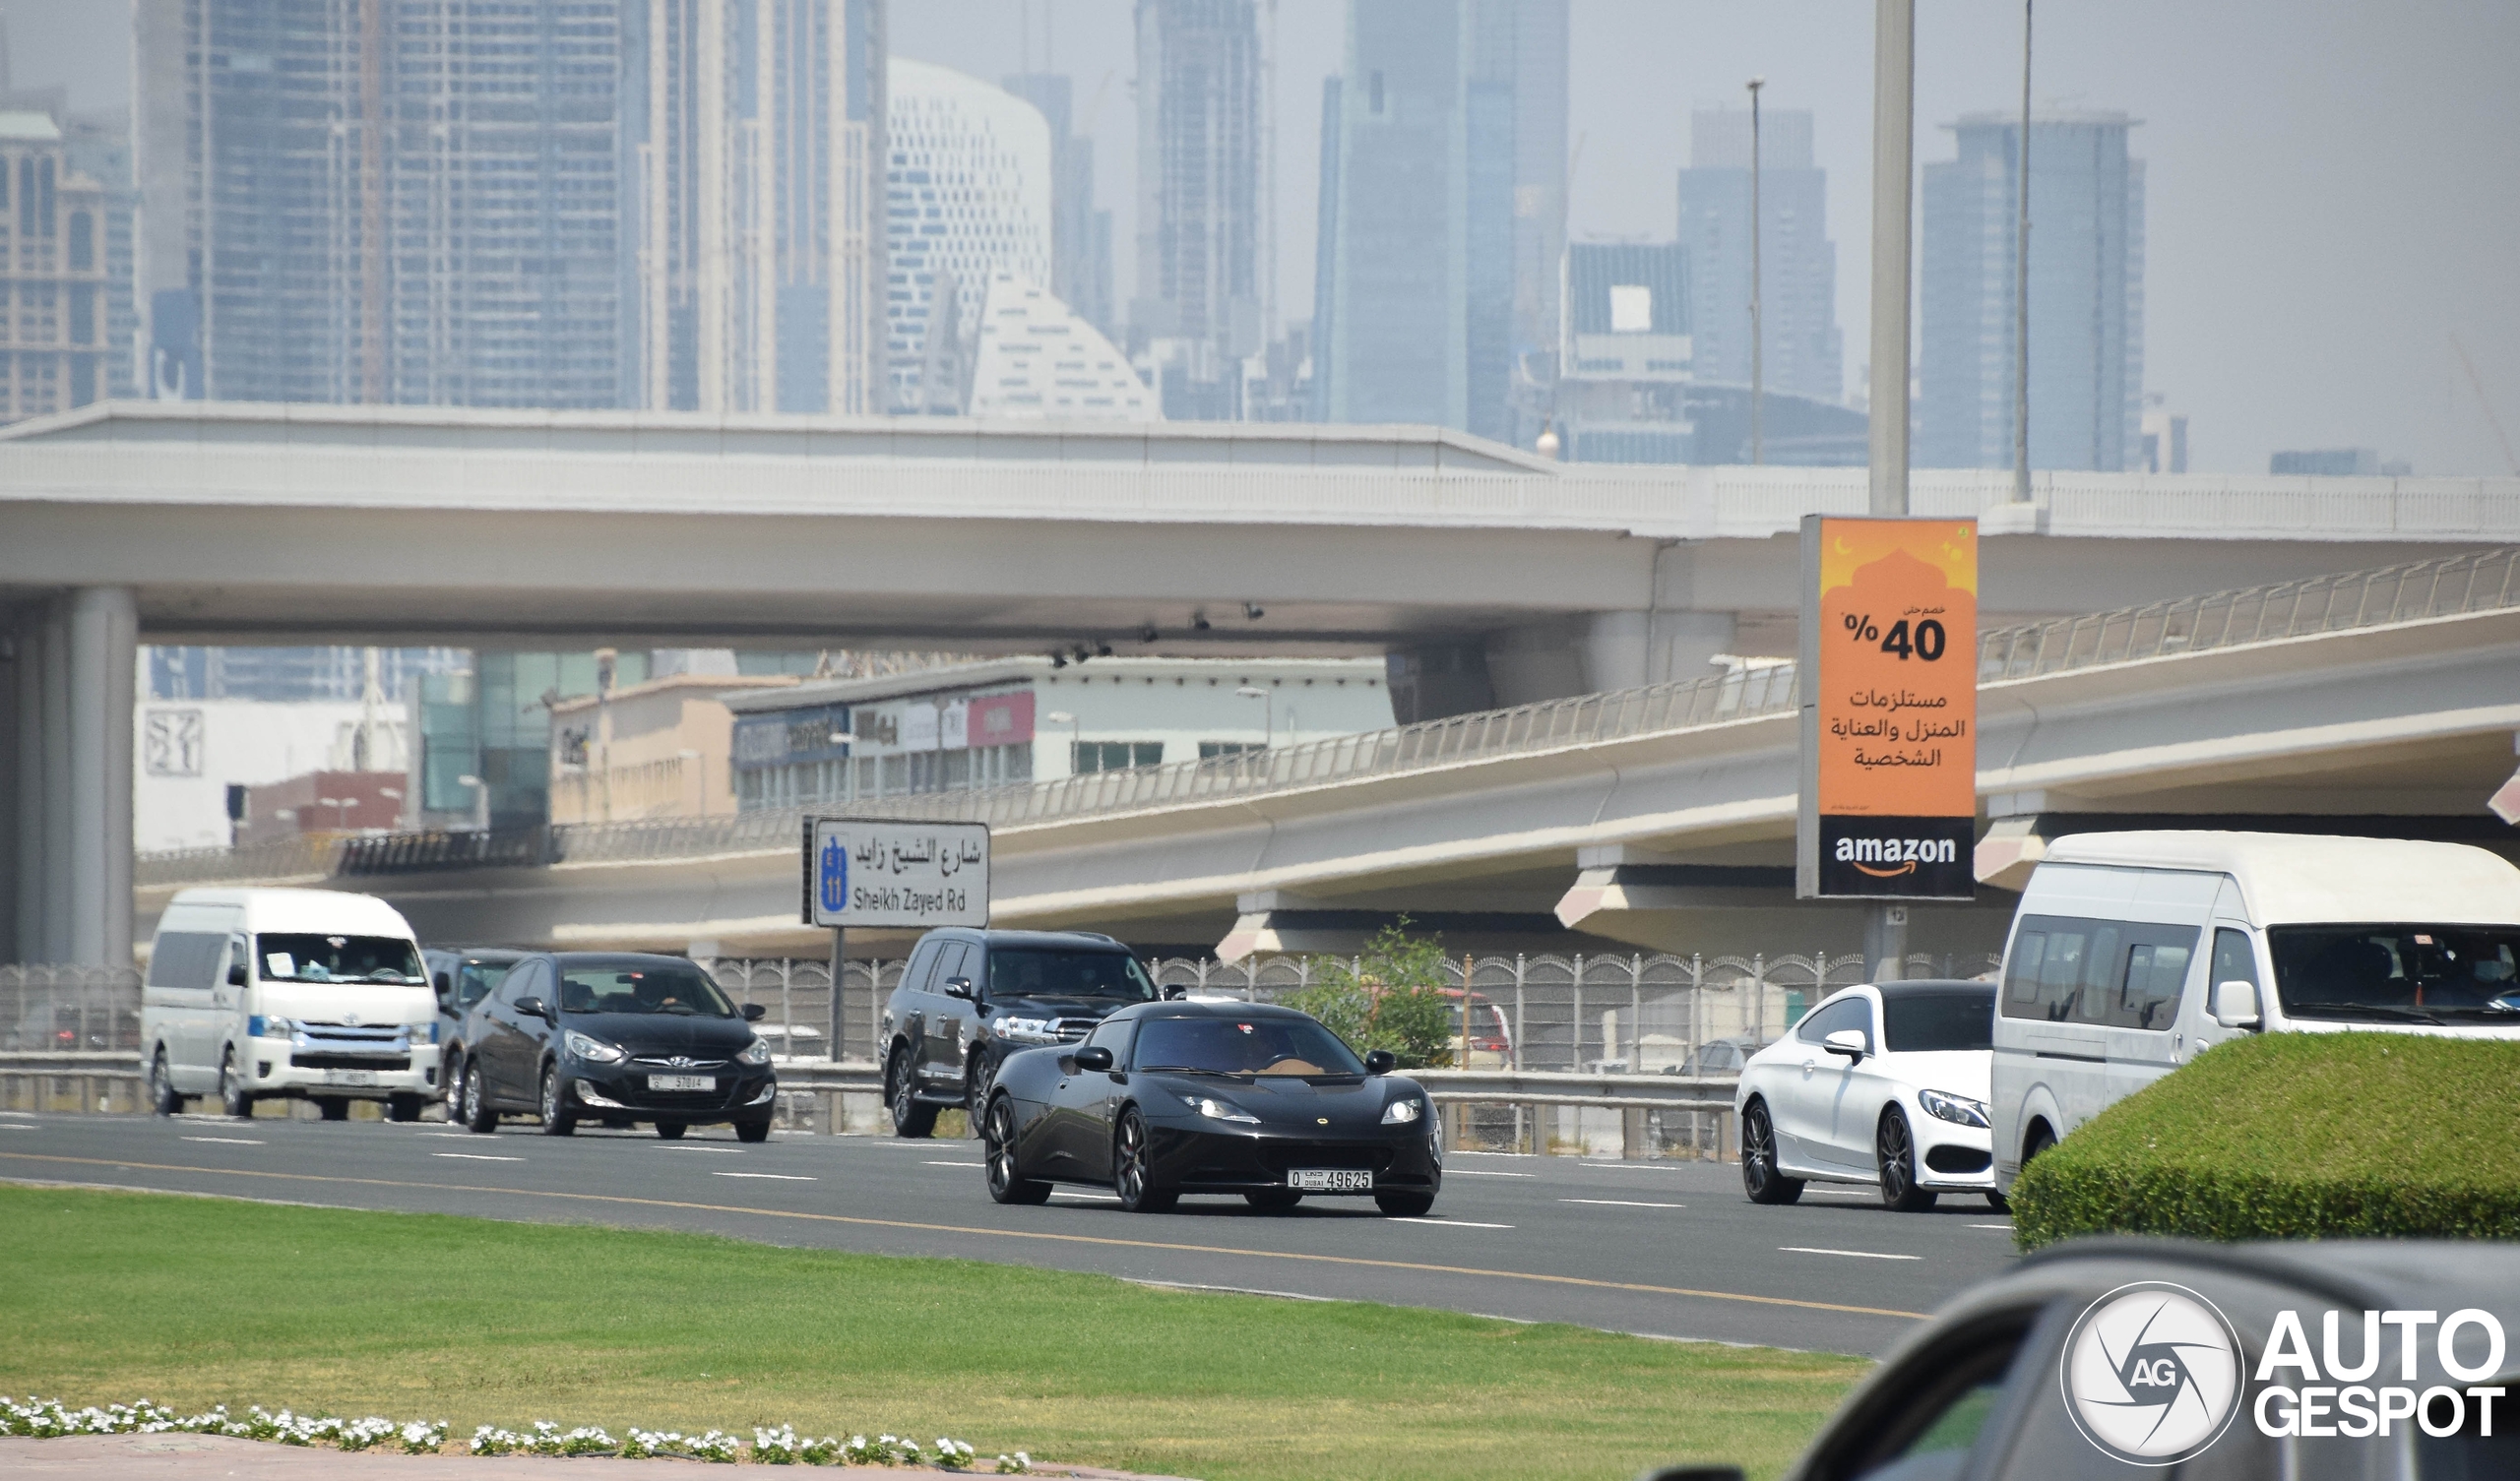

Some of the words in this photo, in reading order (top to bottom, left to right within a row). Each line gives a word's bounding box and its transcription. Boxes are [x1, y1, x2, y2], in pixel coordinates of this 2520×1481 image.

[1850, 689, 1947, 712] مستلزمات
[1831, 717, 1899, 741] والعناية
[1906, 719, 1965, 742] المنزل
[1855, 748, 1941, 771] الشخصية
[855, 837, 886, 870] زايد
[892, 836, 936, 875] الشيخ
[941, 839, 981, 877] شارع
[1836, 837, 1956, 863] amazon
[827, 876, 843, 905] 11
[853, 887, 900, 911] Sheikh
[903, 888, 943, 915] Zayed
[947, 888, 966, 911] Rd
[1292, 1172, 1299, 1186] Q
[1327, 1172, 1369, 1188] 49625
